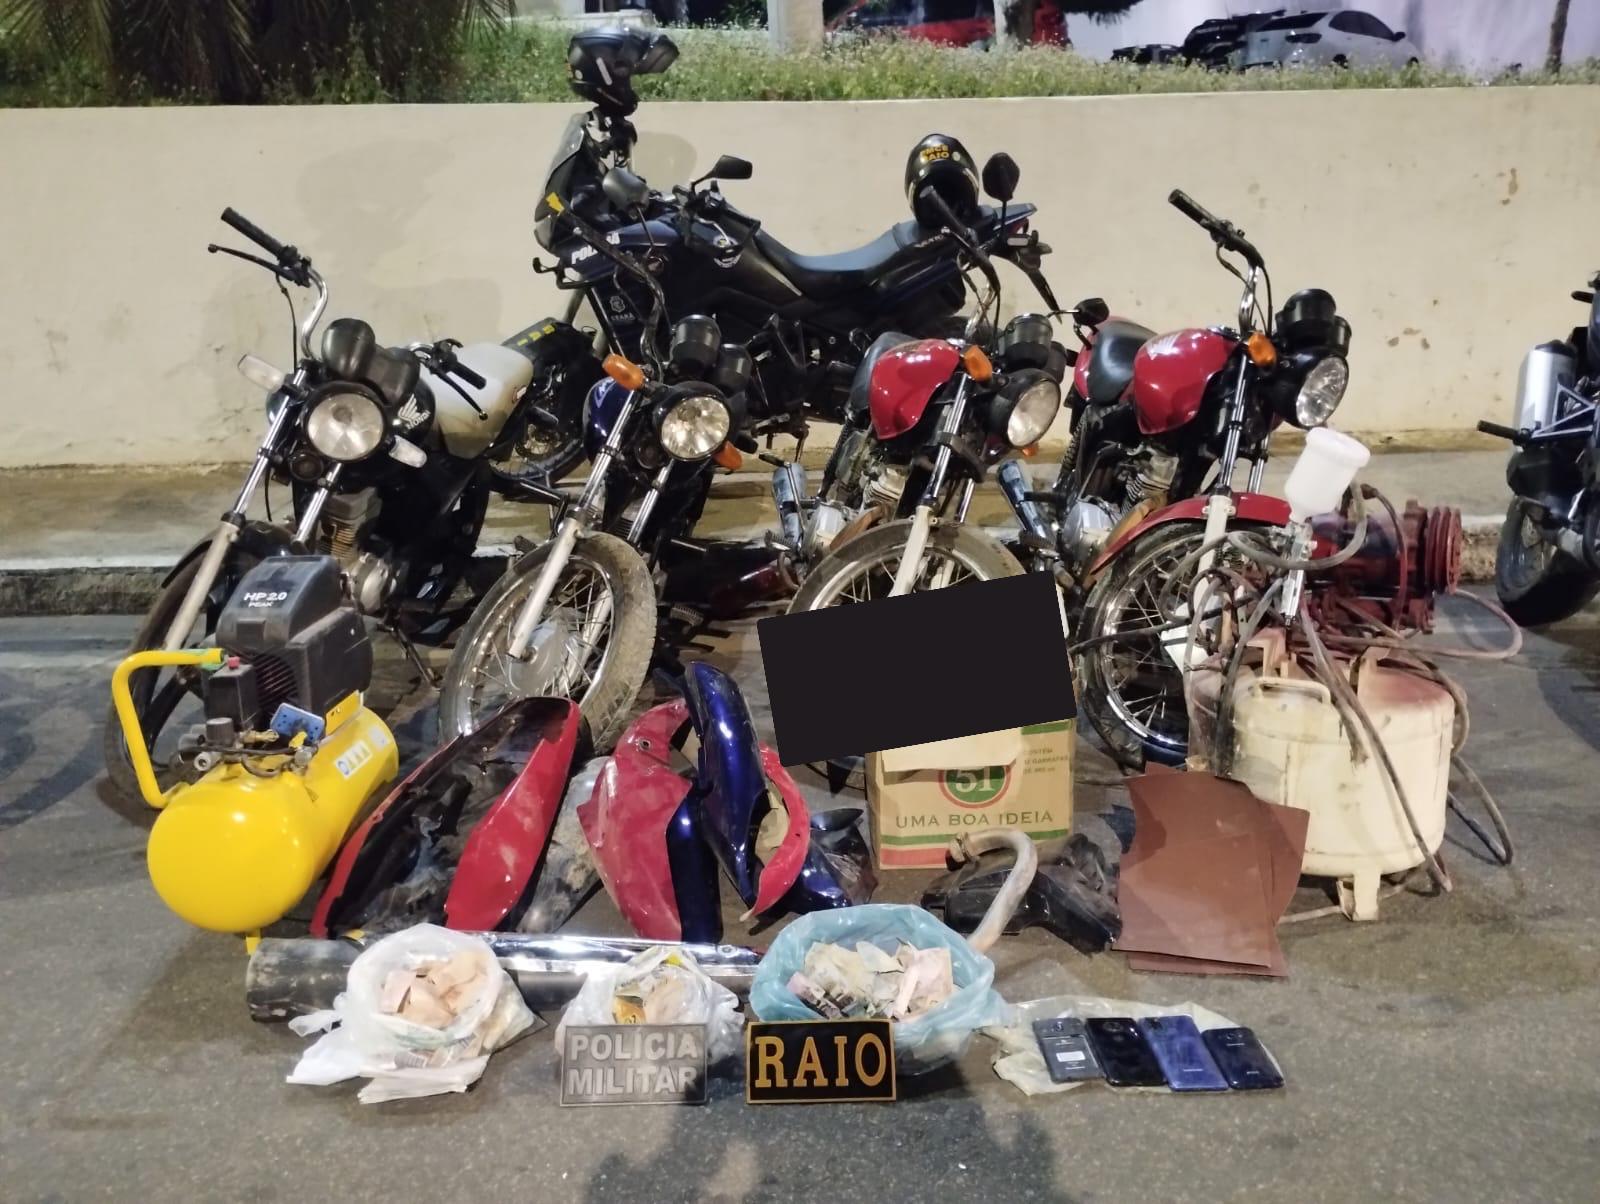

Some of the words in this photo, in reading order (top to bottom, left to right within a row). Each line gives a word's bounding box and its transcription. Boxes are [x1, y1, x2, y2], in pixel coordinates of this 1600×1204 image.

[243, 592, 267, 601] HP
[955, 767, 995, 793] 51
[895, 815, 940, 829] UMA
[949, 813, 990, 826] BOA
[999, 811, 1053, 825] IDEIA
[570, 1028, 698, 1061] POLÍCIA
[755, 1033, 886, 1087] RAIO
[567, 1066, 697, 1096] MILITAR
